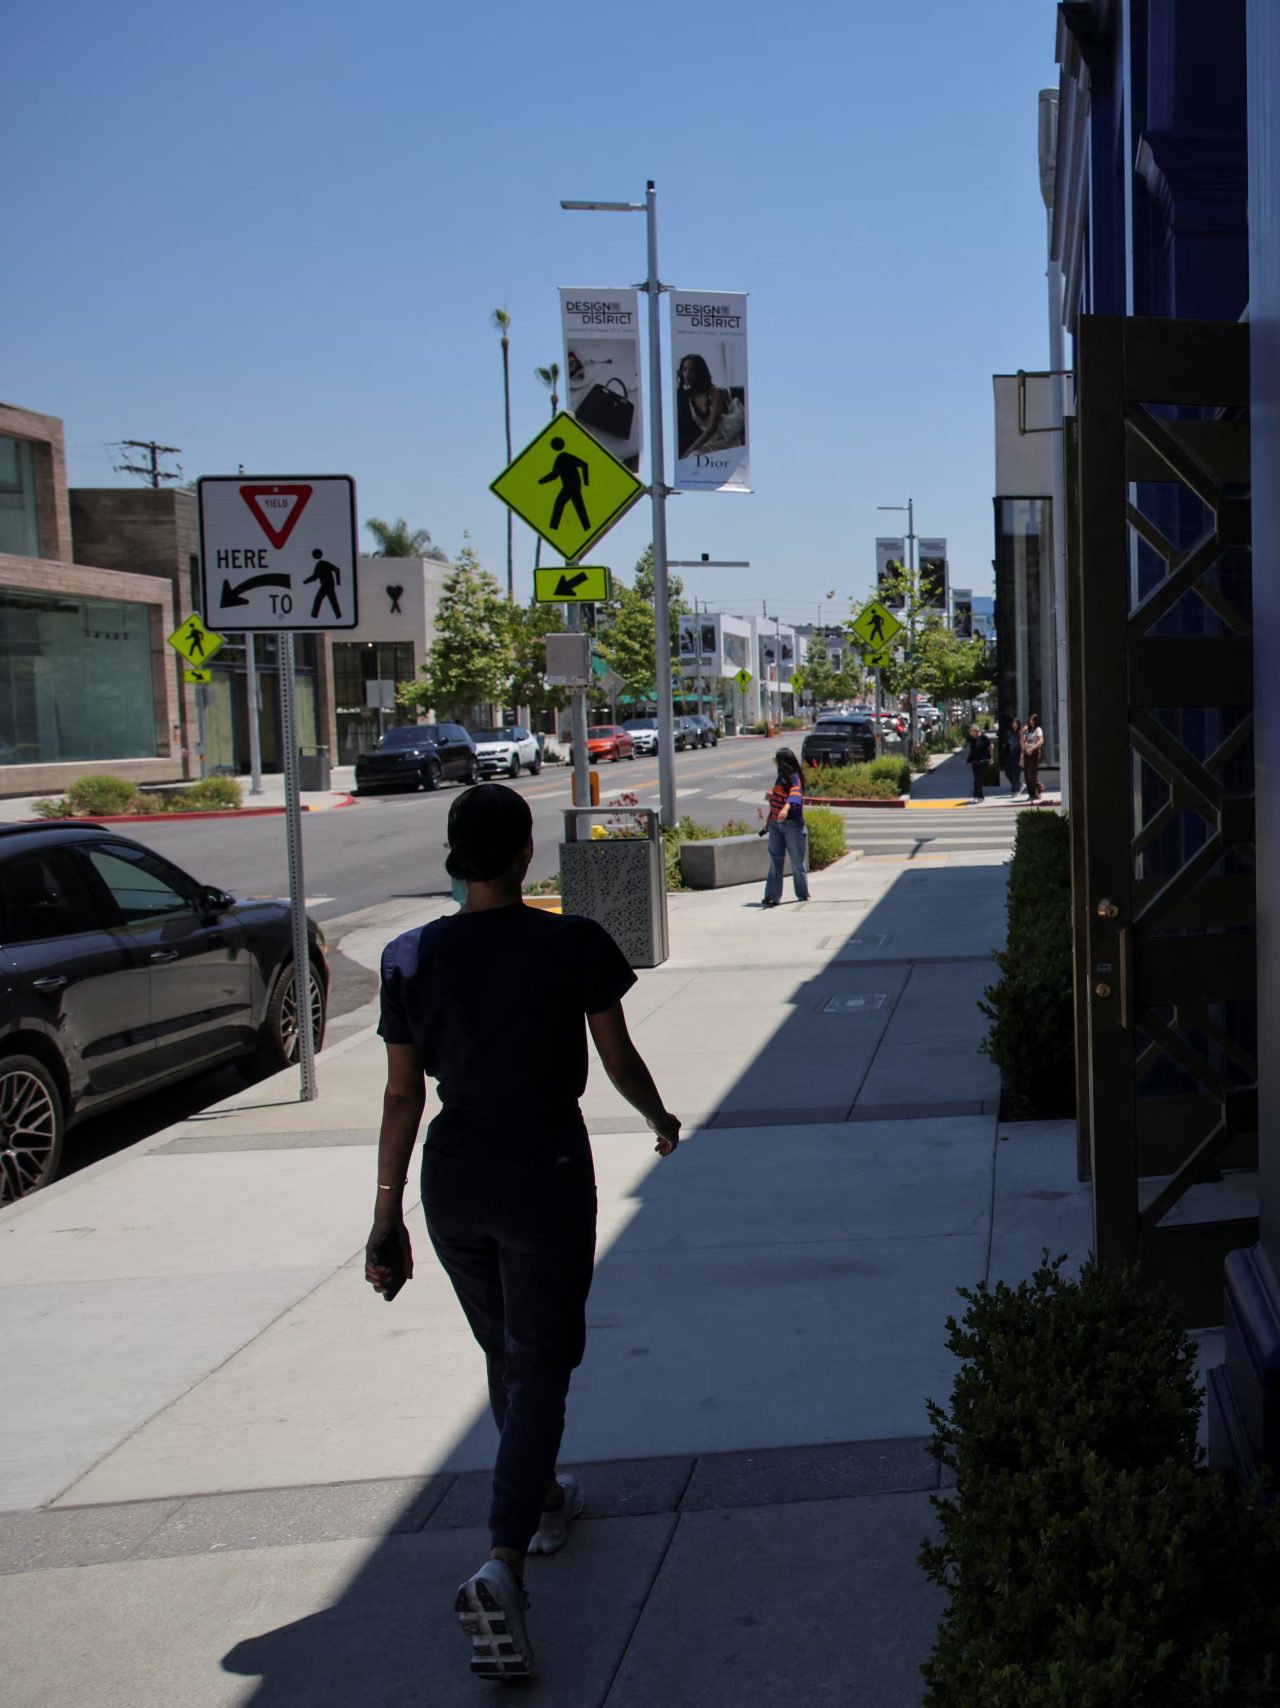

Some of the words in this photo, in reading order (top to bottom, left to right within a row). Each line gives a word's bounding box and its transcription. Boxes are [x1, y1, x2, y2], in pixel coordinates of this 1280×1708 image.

[566, 301, 611, 312] DESIGN
[676, 304, 720, 315] DESIGN
[582, 313, 632, 324] DISTRICT
[691, 316, 741, 328] DISTRICT
[696, 454, 729, 468] Dior
[264, 499, 288, 508] YIELD
[217, 549, 269, 569] HERE
[268, 594, 293, 614] TO
